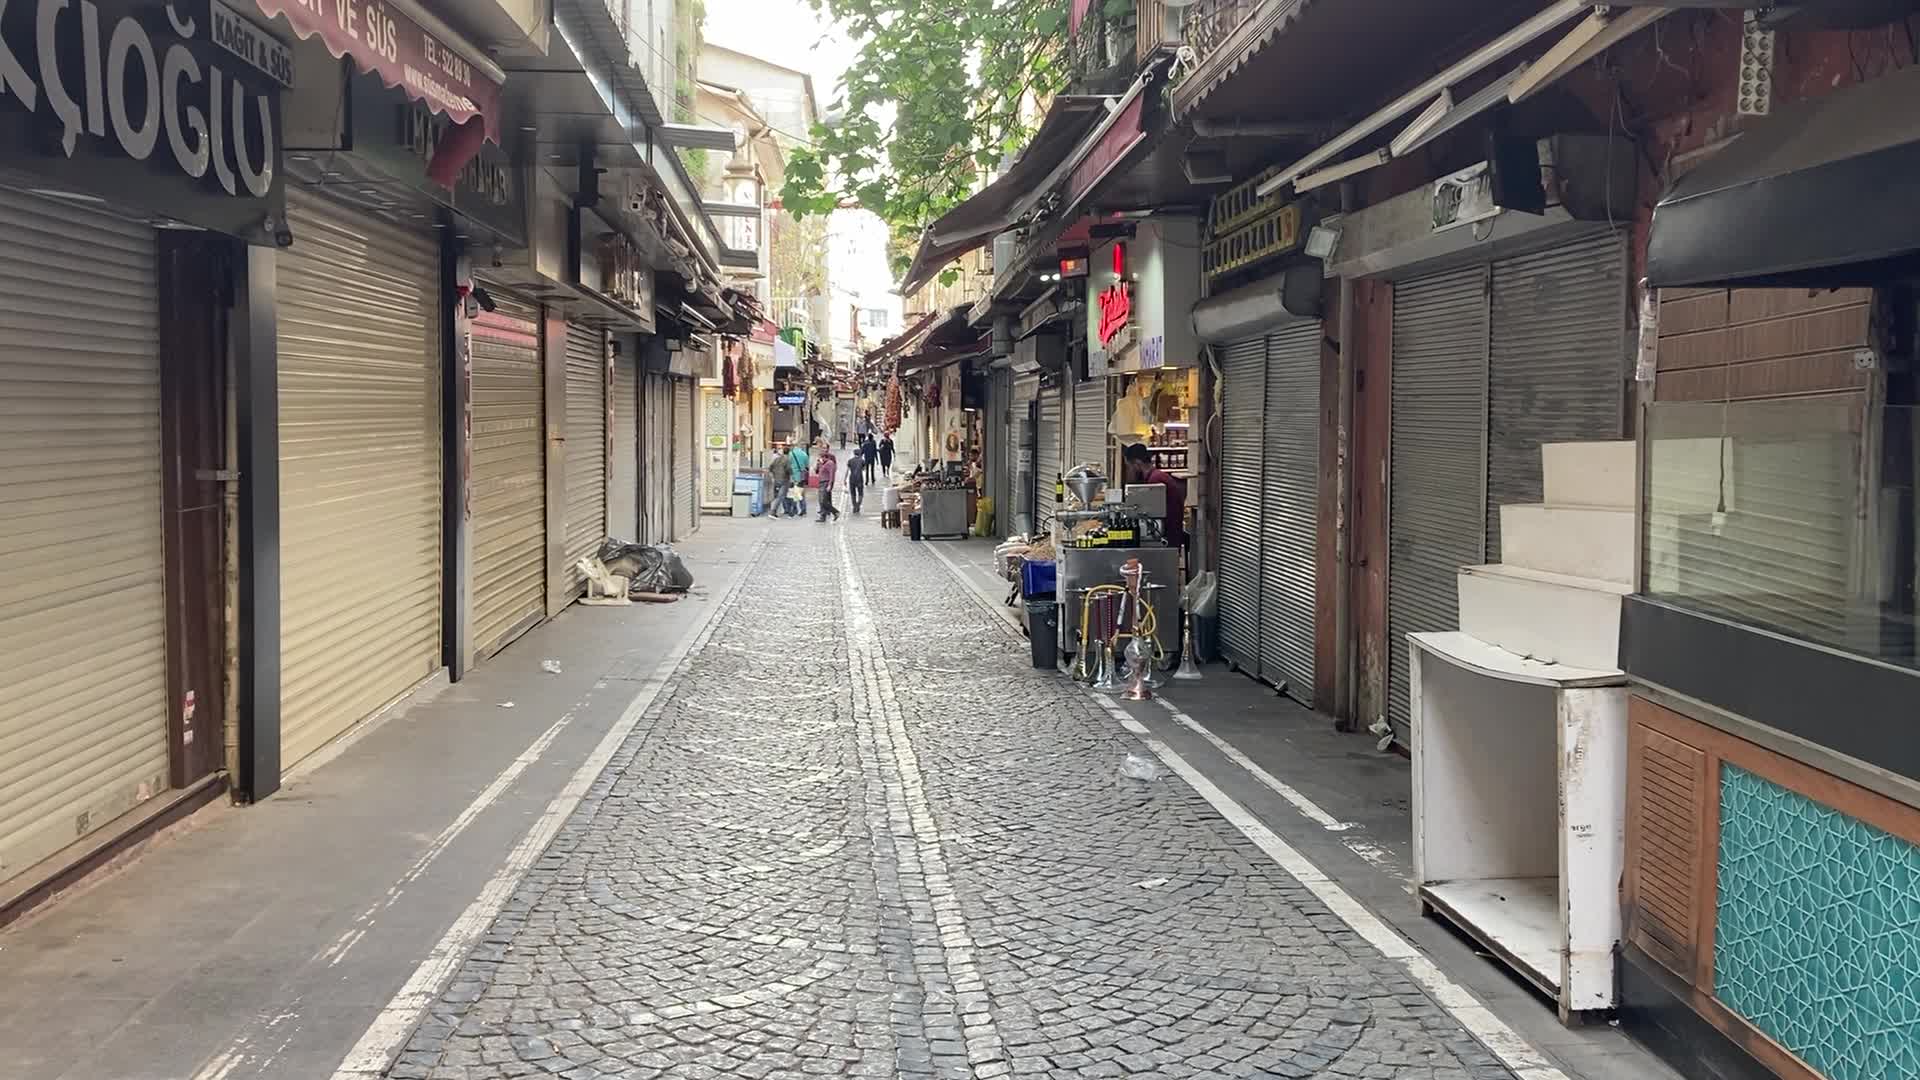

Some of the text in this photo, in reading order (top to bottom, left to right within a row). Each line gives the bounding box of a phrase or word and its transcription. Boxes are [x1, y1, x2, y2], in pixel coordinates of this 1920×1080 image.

[215, 12, 255, 62] KAĞIT
[271, 45, 292, 84] SÜS
[335, 0, 397, 63] VE SÜS
